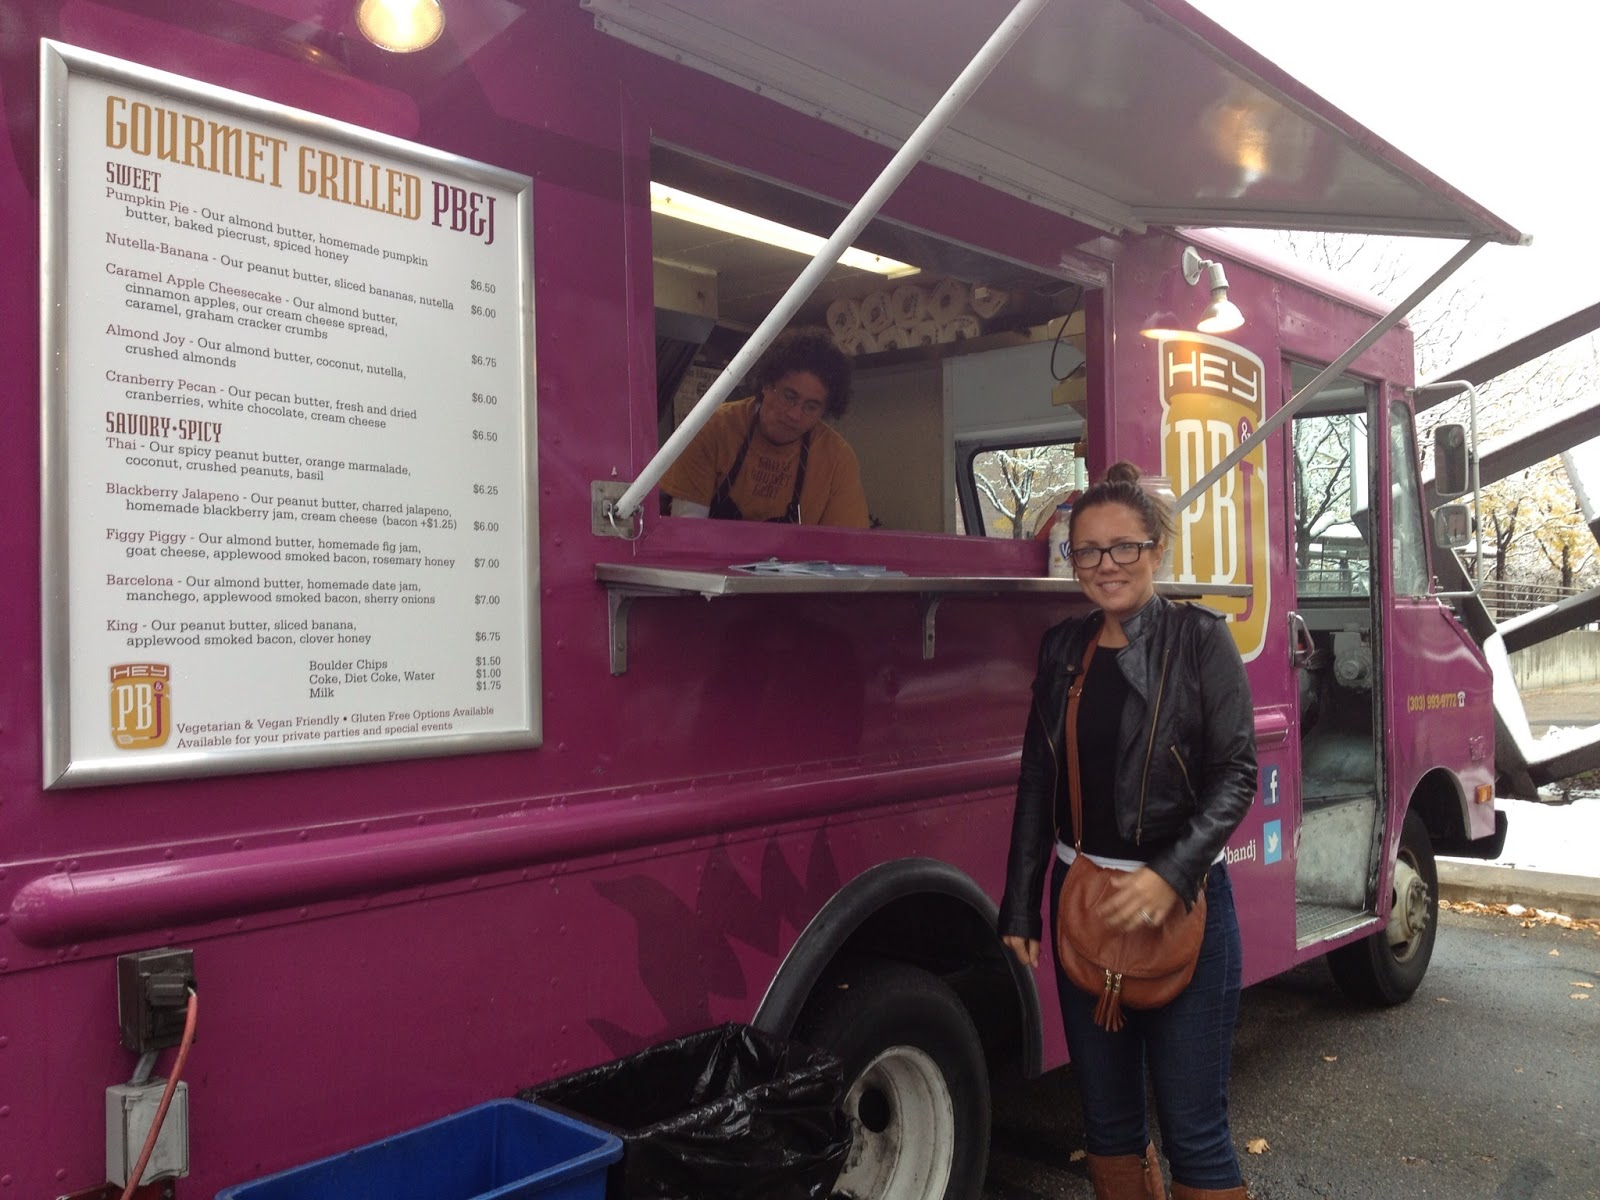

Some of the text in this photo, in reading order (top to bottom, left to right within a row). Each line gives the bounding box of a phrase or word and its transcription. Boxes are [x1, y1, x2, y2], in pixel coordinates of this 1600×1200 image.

[105, 95, 497, 246] GOURMET GRILLED PB&J
[105, 160, 162, 194] SWEET
[105, 186, 429, 267] Pumpkin Pie almond homemade pumpkin
[174, 215, 350, 265] baked piecrust, spiced honey
[105, 231, 455, 311] Nutella-Banana peanut sliced bananas, nutella
[105, 262, 360, 319] Caramel Apple Cheesecake almond
[470, 279, 496, 294] $6.50
[124, 298, 328, 340] caramel, graham cracker crumbs
[125, 281, 388, 338] cinnamon apples, our cream cheese spread,
[470, 304, 497, 319] $6.00
[105, 323, 406, 380] Almond Joy almond coconut, nutella,
[124, 344, 237, 369] crushed almonds
[471, 353, 497, 368] $6.75
[1168, 351, 1258, 403] HEY
[105, 369, 417, 420] Cranberry Pecan pecan fresh and dried
[471, 391, 498, 406] $6.00
[124, 389, 387, 429] cranberries, white chocolate, cream cheese
[472, 428, 498, 442] $6.50
[105, 436, 411, 477] Thai spicy peanut orange marmalade,
[125, 456, 325, 481] coconut, crushed peanuts, basil
[105, 482, 452, 518] Blackberry Jalapeno peanut charred jalapeno,
[472, 483, 499, 496] $6.25
[125, 498, 458, 531] homemade blackberry jam, cream cheese (bacon +$1.25)
[473, 520, 500, 533] $6.00
[105, 527, 422, 555] Figgy Piggy almond homemade fig jam,
[125, 545, 456, 569] goat cheese, applewood smoked bacon, rosemary honey
[473, 557, 500, 569] $7.00
[106, 573, 421, 593] Barcelona almond homemade date jam,
[125, 589, 436, 606] manchego, applewood smoked bacon, sherry onions
[474, 594, 501, 606] $7.00
[106, 619, 357, 634] King peanut butter, sliced banana,
[474, 630, 501, 643] $6.75
[126, 632, 372, 649] applewood smoked bacon, clover honey
[113, 664, 169, 680] HEY
[308, 658, 388, 672] Boulder Chips
[475, 655, 501, 667] $1.50
[308, 670, 435, 685] Coke, Diet Coke, Water
[475, 668, 502, 680] $1.00
[309, 686, 335, 699] Milk
[475, 680, 502, 692] $1.75
[1407, 693, 1426, 713] (303)
[176, 706, 495, 736] Vegetarian & Vegan Friendly Gluten Free Options Available
[176, 722, 453, 749] Available for your private parties and special events
[1225, 838, 1257, 865] bandj
